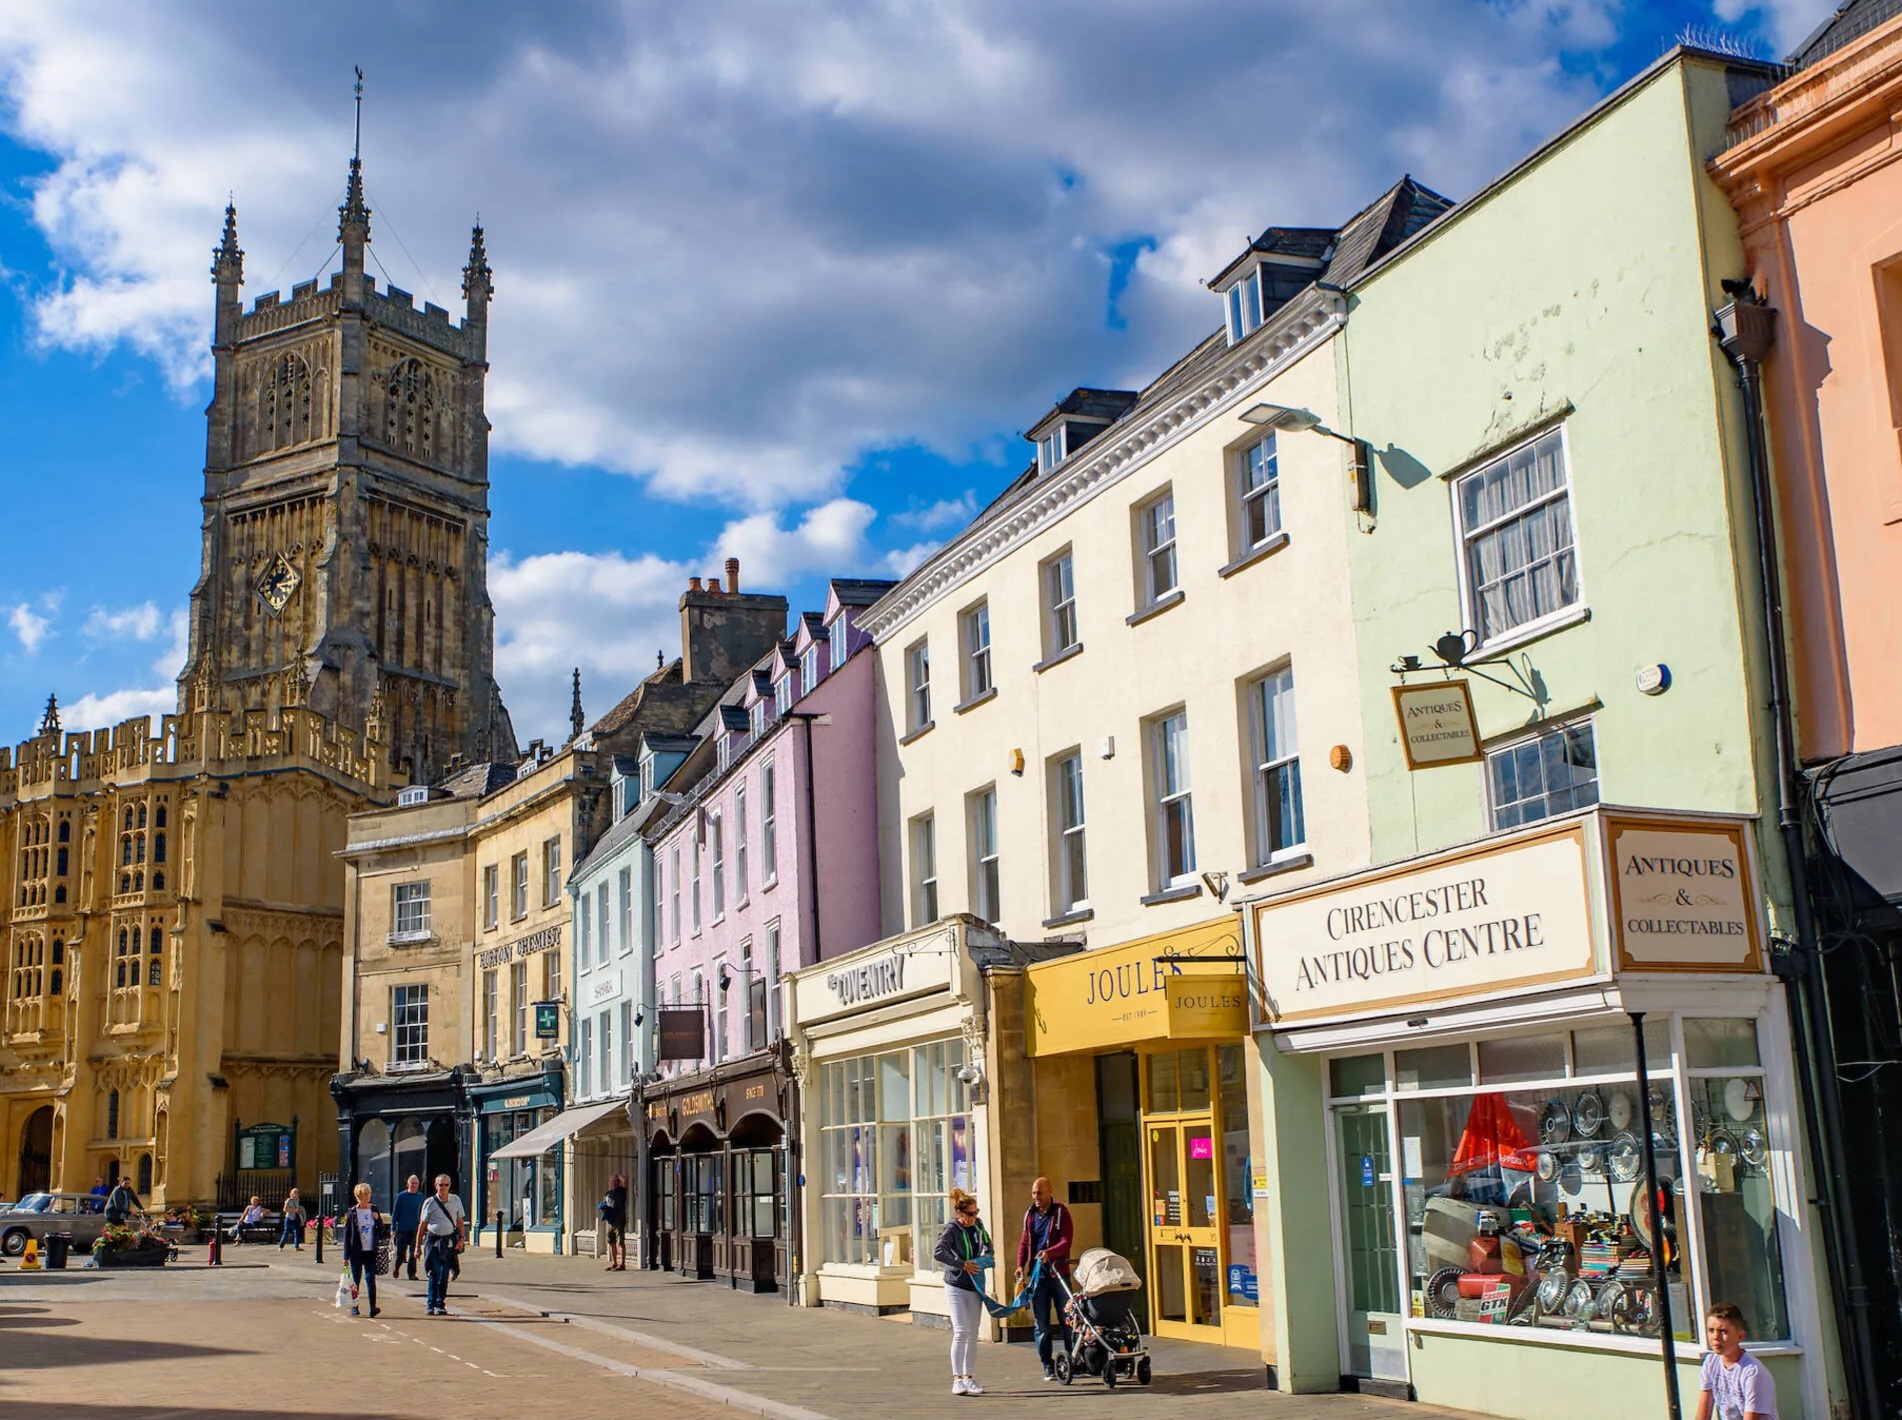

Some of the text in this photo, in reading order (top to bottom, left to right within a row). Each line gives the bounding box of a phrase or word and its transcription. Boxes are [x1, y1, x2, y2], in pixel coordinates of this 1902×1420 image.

[1408, 701, 1463, 718] ANTIQUES
[1434, 719, 1444, 729] &
[1410, 730, 1470, 743] COLLECTABLES
[1625, 855, 1735, 879] ANTIQUES
[1675, 888, 1694, 906] &
[1327, 878, 1489, 941] CIRENCESTER
[1627, 919, 1745, 936] COLLECTABLES
[517, 925, 562, 957] CHEMIST
[1296, 913, 1545, 992] ANTIQUES CENTRE
[837, 954, 905, 1006] COVENTRY
[1175, 996, 1241, 1010] JOULES
[1481, 1298, 1508, 1310] GTX
